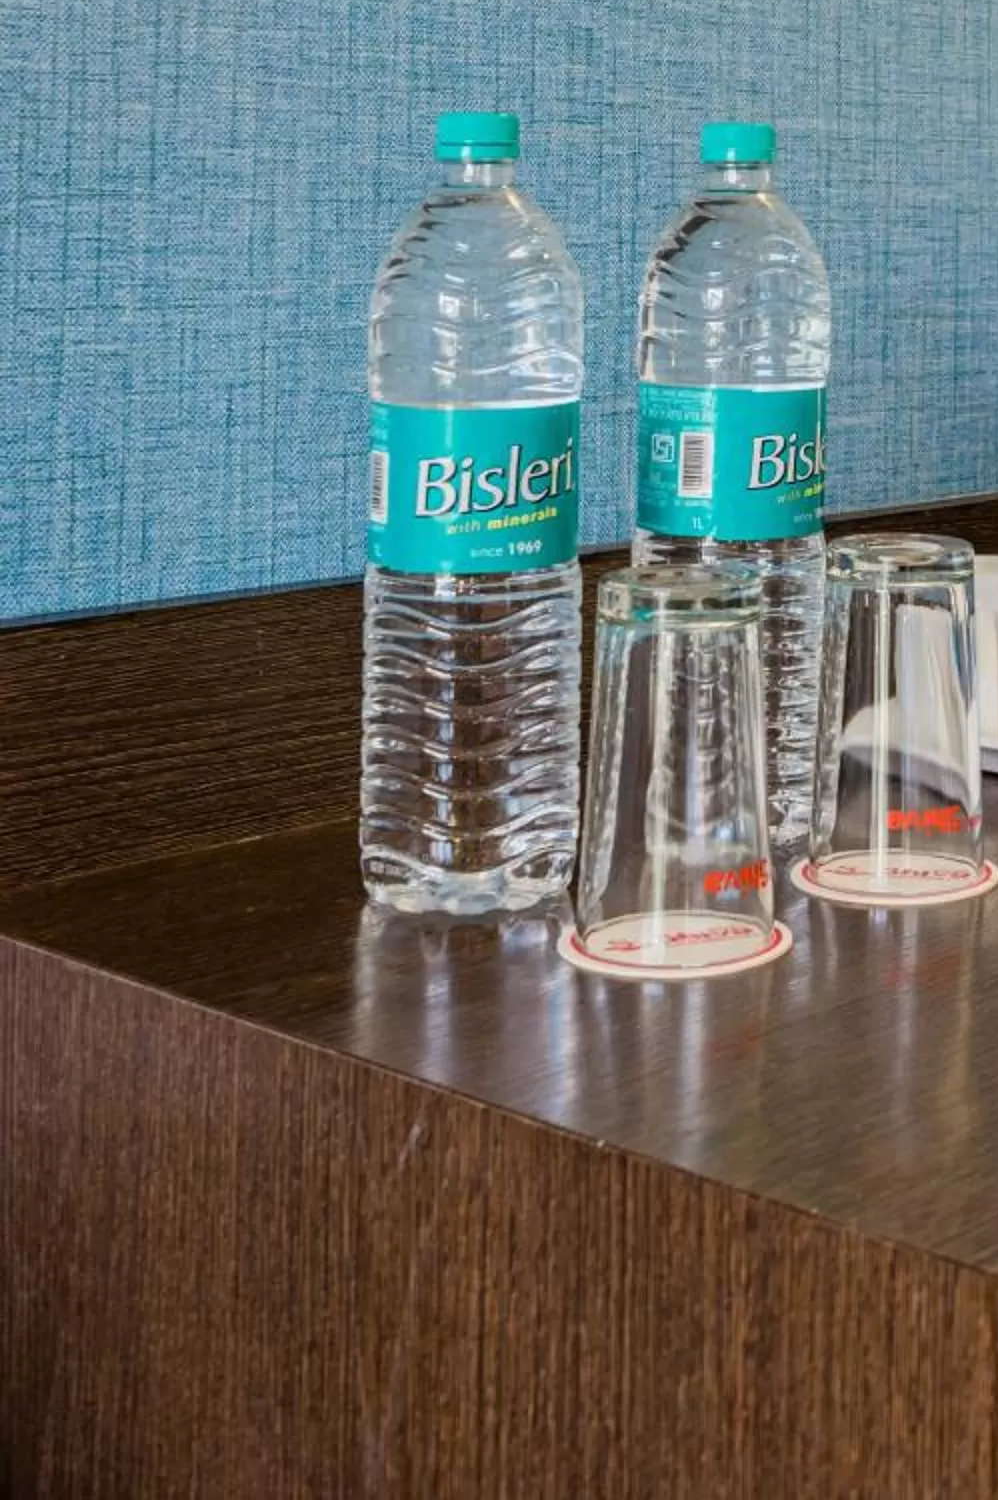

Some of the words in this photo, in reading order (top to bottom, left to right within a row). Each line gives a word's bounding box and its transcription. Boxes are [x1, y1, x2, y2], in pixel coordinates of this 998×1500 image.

[415, 437, 573, 517] Bisleri
[447, 520, 481, 535] with
[487, 506, 558, 530] minerals
[469, 546, 504, 558] since
[507, 539, 543, 556] 1969
